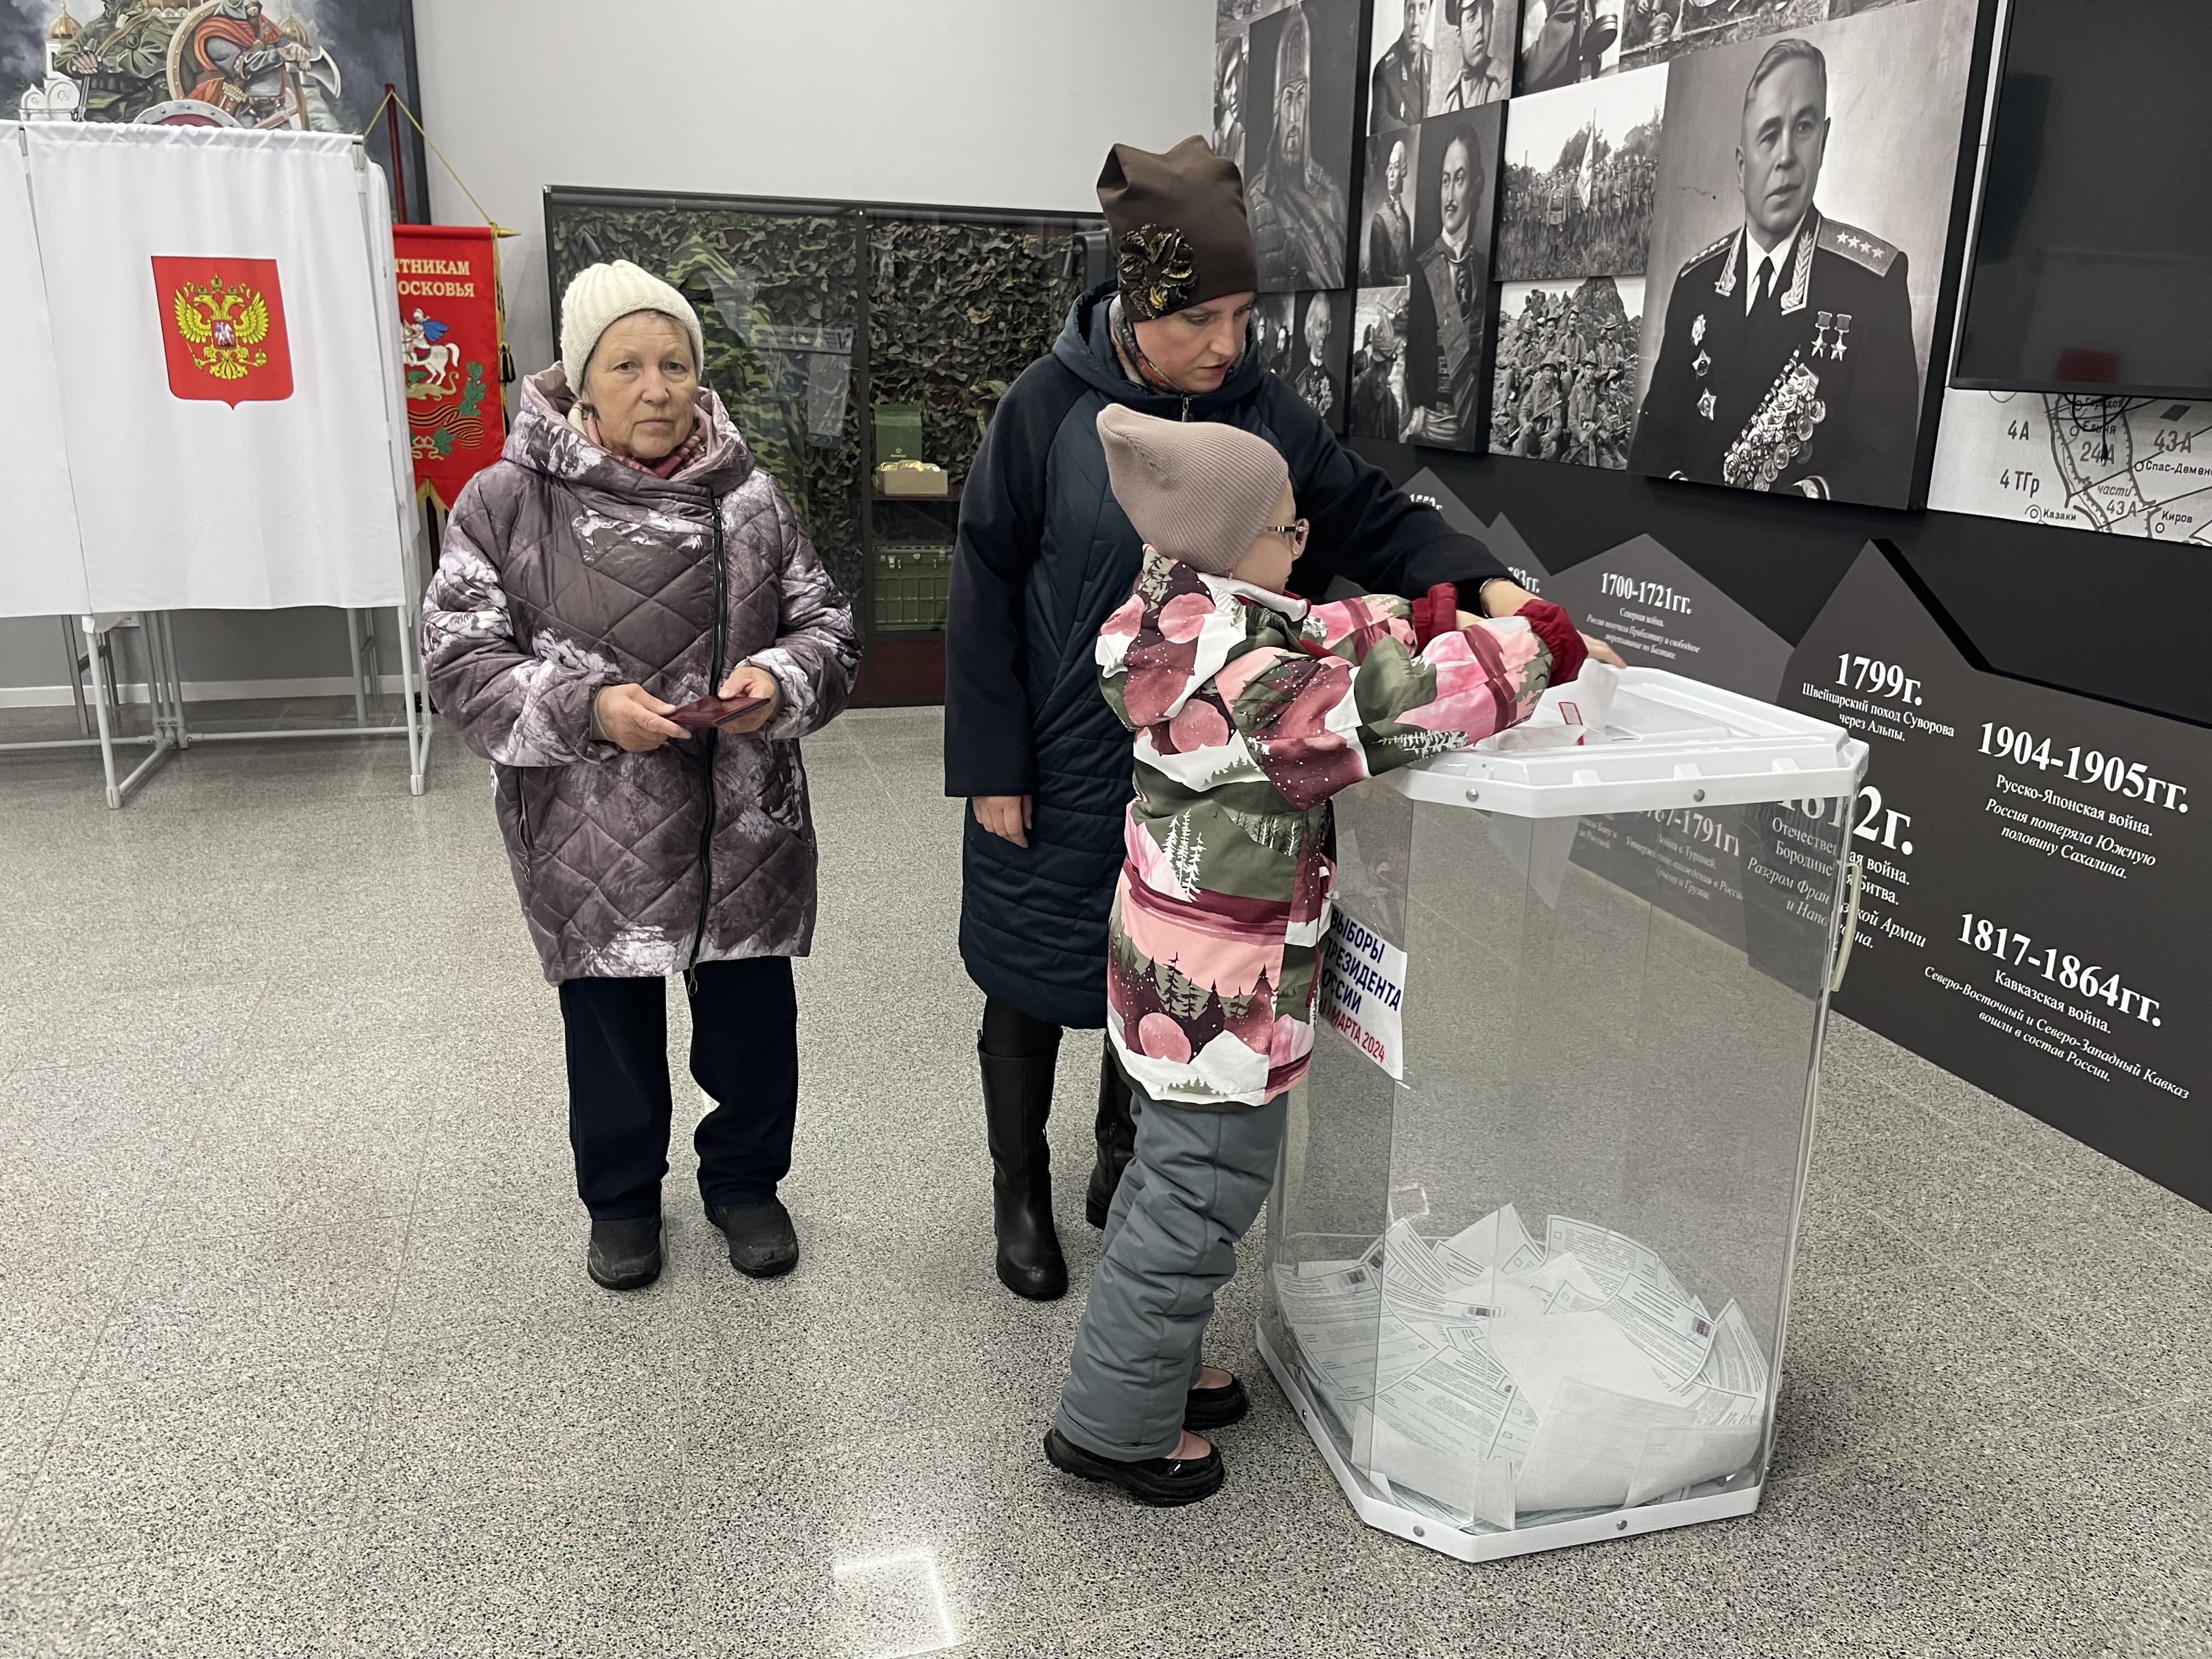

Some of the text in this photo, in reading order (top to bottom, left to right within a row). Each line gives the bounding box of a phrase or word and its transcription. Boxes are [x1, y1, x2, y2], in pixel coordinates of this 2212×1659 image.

[398, 280, 475, 297] ОСКОВЬЯ
[2044, 509, 2076, 521] Казаки
[2097, 484, 2132, 496] части
[2162, 510, 2193, 523] Киров
[1601, 572, 1691, 614] 1700-1721гг.
[1835, 653, 1922, 706] 1799г.
[1802, 682, 1955, 737] Швейцарский поход Суворова
[1839, 714, 1905, 741] через Альпы.
[1977, 722, 2188, 813] 1904-1905гг.
[1996, 774, 2153, 836] Русско-Японская война.
[1985, 799, 2156, 866] Россия потеряла Южную
[2001, 826, 2127, 878] половину Сахалина.
[1866, 857, 1910, 885] война.
[1747, 857, 1794, 889] Разгром
[1880, 917, 1927, 947] Армии
[1786, 899, 1795, 911] и
[1330, 908, 1385, 963] ВЫБОРЫ
[1322, 967, 1362, 1014] ОССИИ
[1958, 913, 2162, 1027] 1817-1864гг.
[1995, 969, 2112, 1034] Кавказская война.
[1331, 1005, 1361, 1043] МАРТА
[1361, 1031, 1385, 1063] 2024
[1925, 966, 2190, 1099] Северо-Восточный и Северо-Западный Кавказ
[1978, 1011, 2111, 1082] вошли в состав России.
